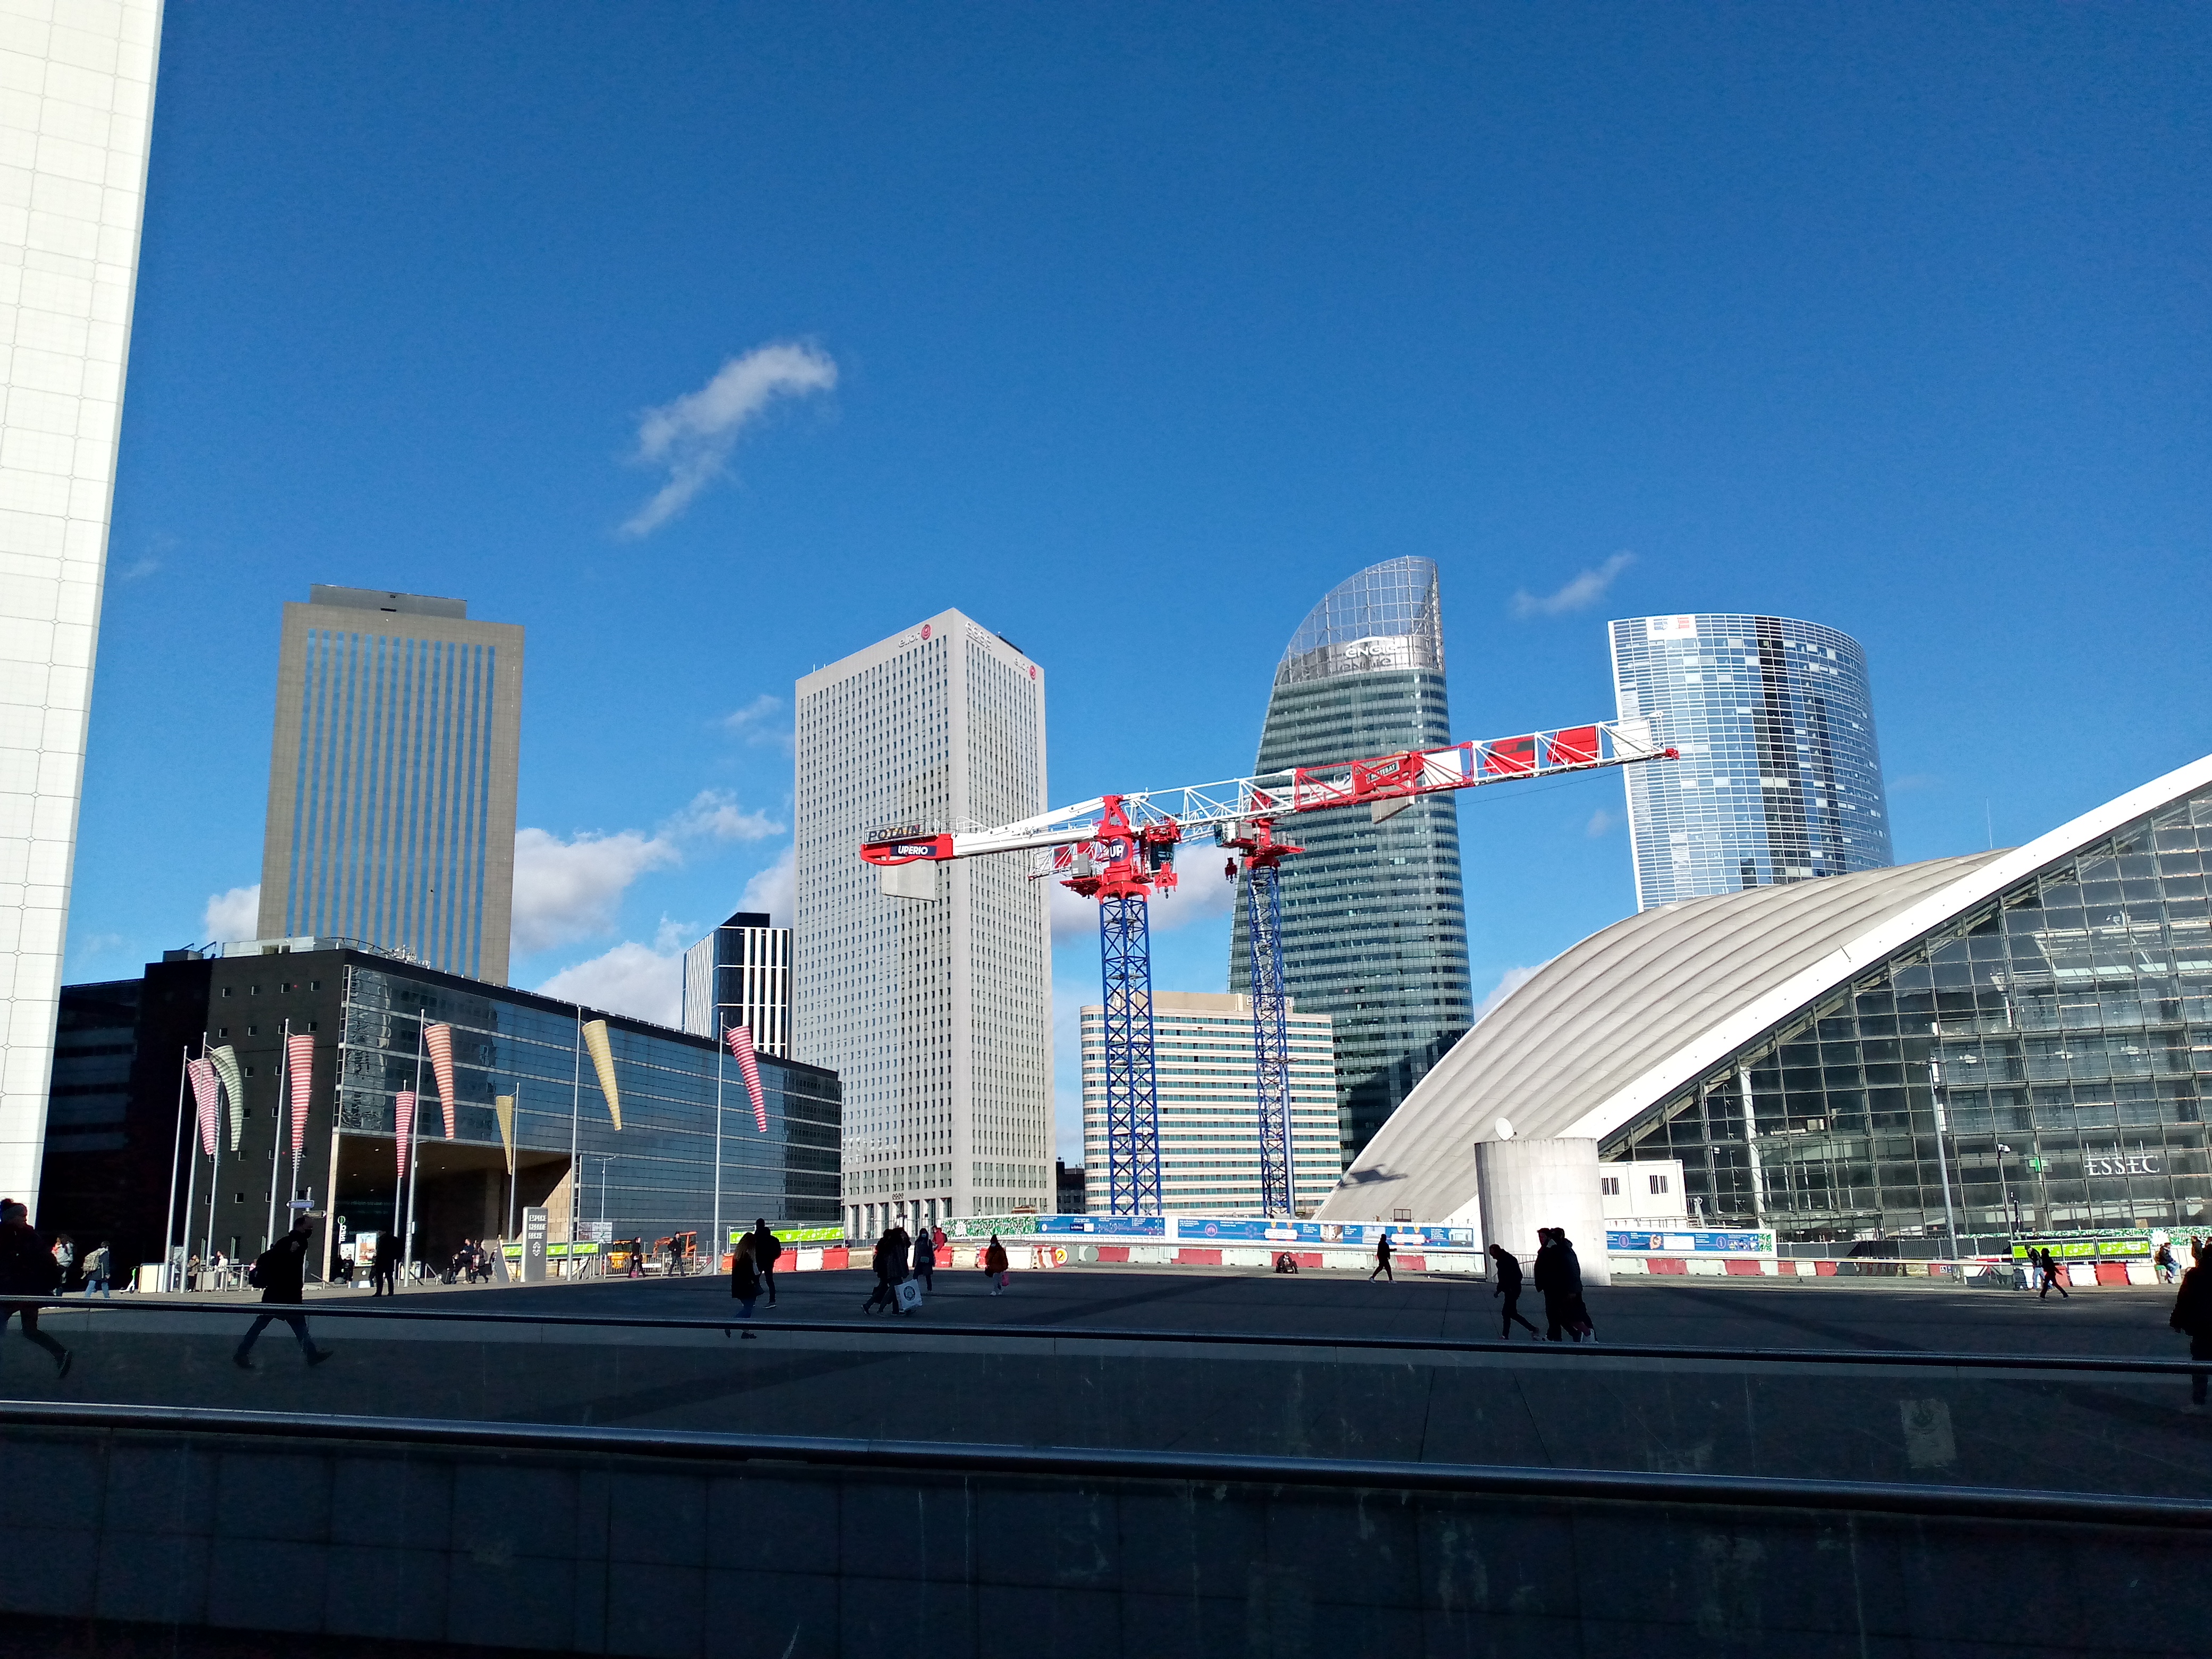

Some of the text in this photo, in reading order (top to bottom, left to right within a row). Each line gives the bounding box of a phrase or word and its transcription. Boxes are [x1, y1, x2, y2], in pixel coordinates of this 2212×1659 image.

[1370, 763, 1397, 781] MTEBAT
[868, 825, 920, 842] POTAIN
[898, 845, 928, 855] UPERIO
[1110, 844, 1124, 858] UP
[2084, 1150, 2160, 1176] ESSEC
